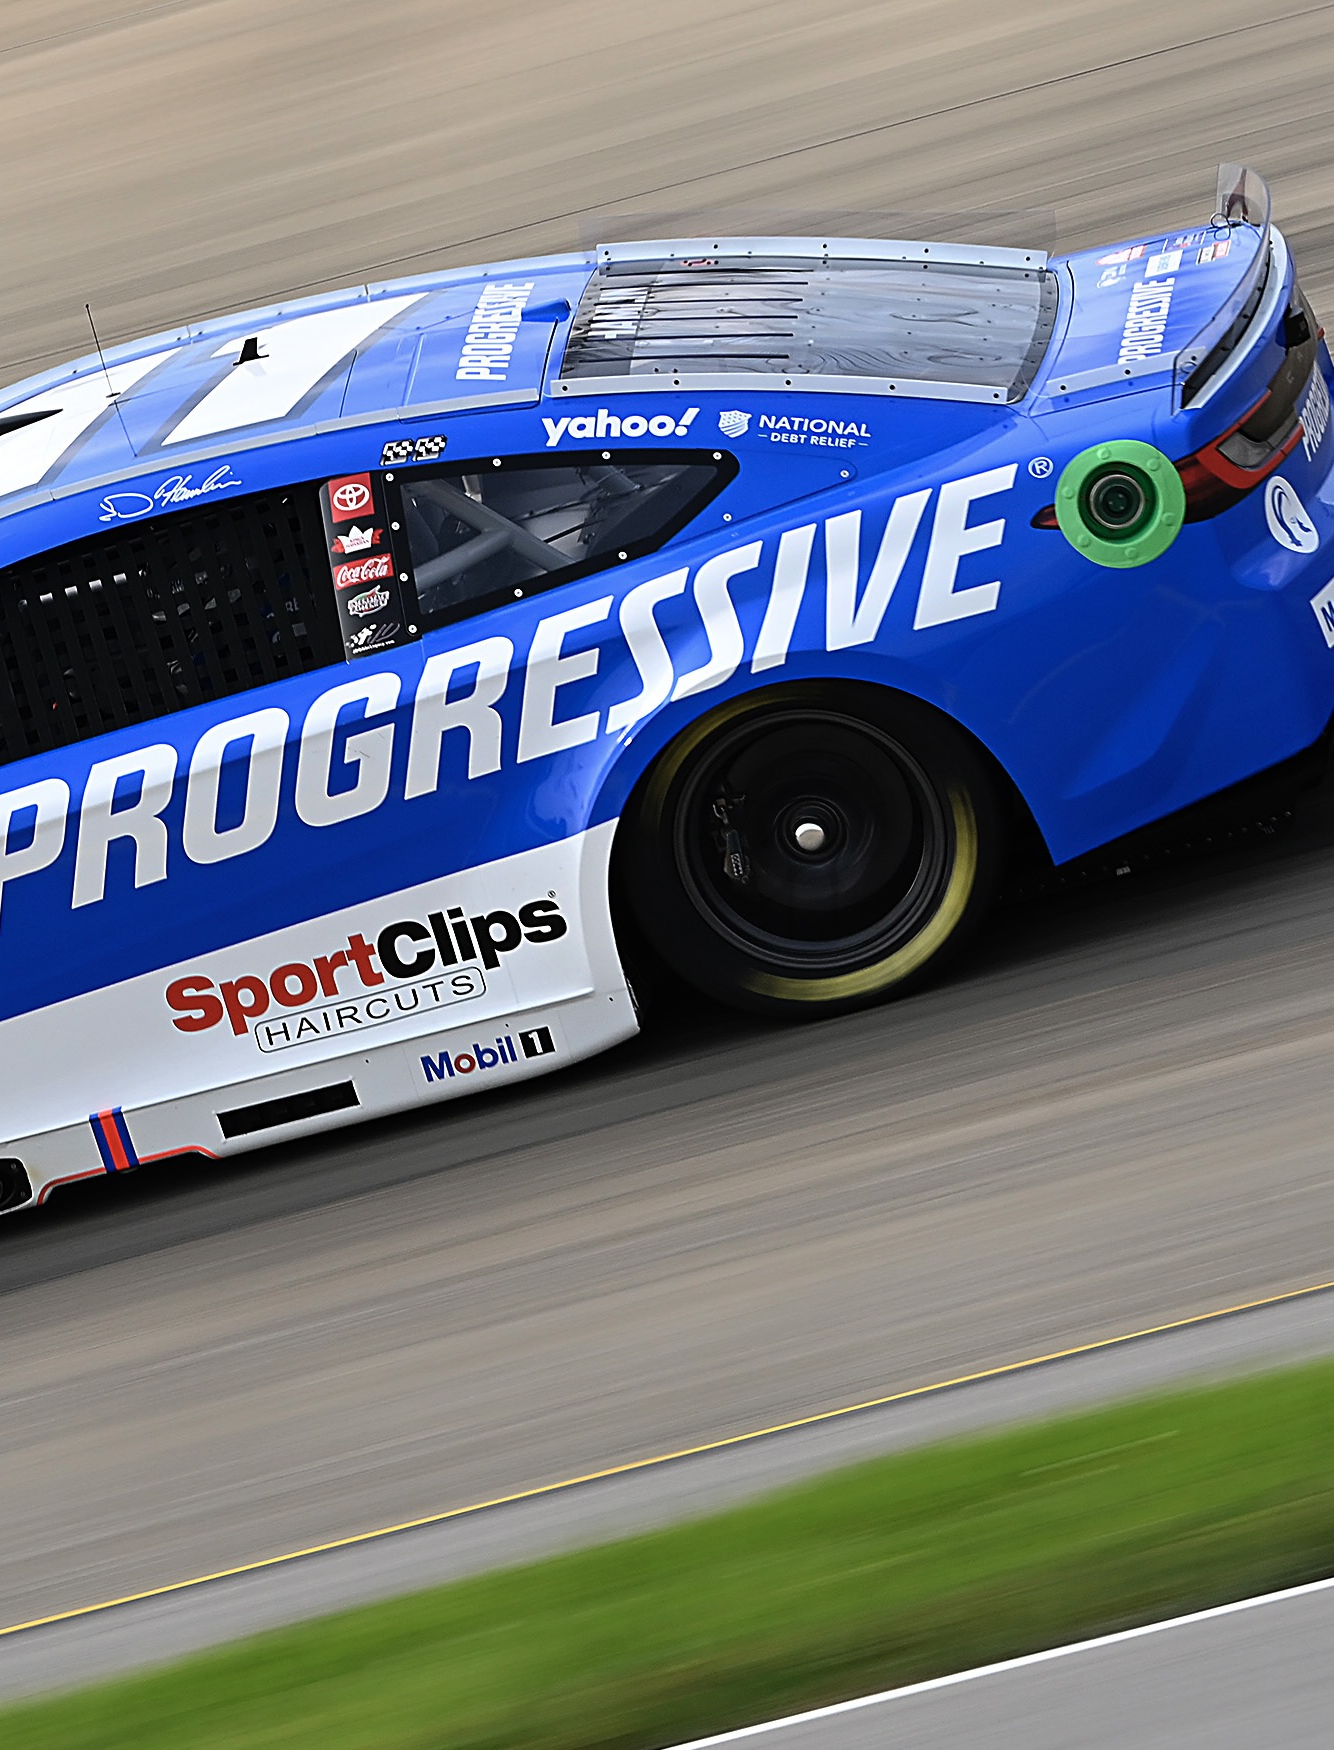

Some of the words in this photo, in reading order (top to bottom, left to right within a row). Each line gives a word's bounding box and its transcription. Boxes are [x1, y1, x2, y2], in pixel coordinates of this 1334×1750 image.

[455, 282, 535, 381] PROGRESSIVE
[542, 407, 700, 447] yahoo!
[759, 414, 871, 437] NATIONAL
[770, 432, 809, 445] DEBT
[810, 435, 857, 448] RELIEF
[1298, 359, 1330, 463] PROGRE
[167, 897, 568, 1036] SportClips
[265, 972, 476, 1047] HAIRCUTS
[422, 1033, 518, 1083] Mobil
